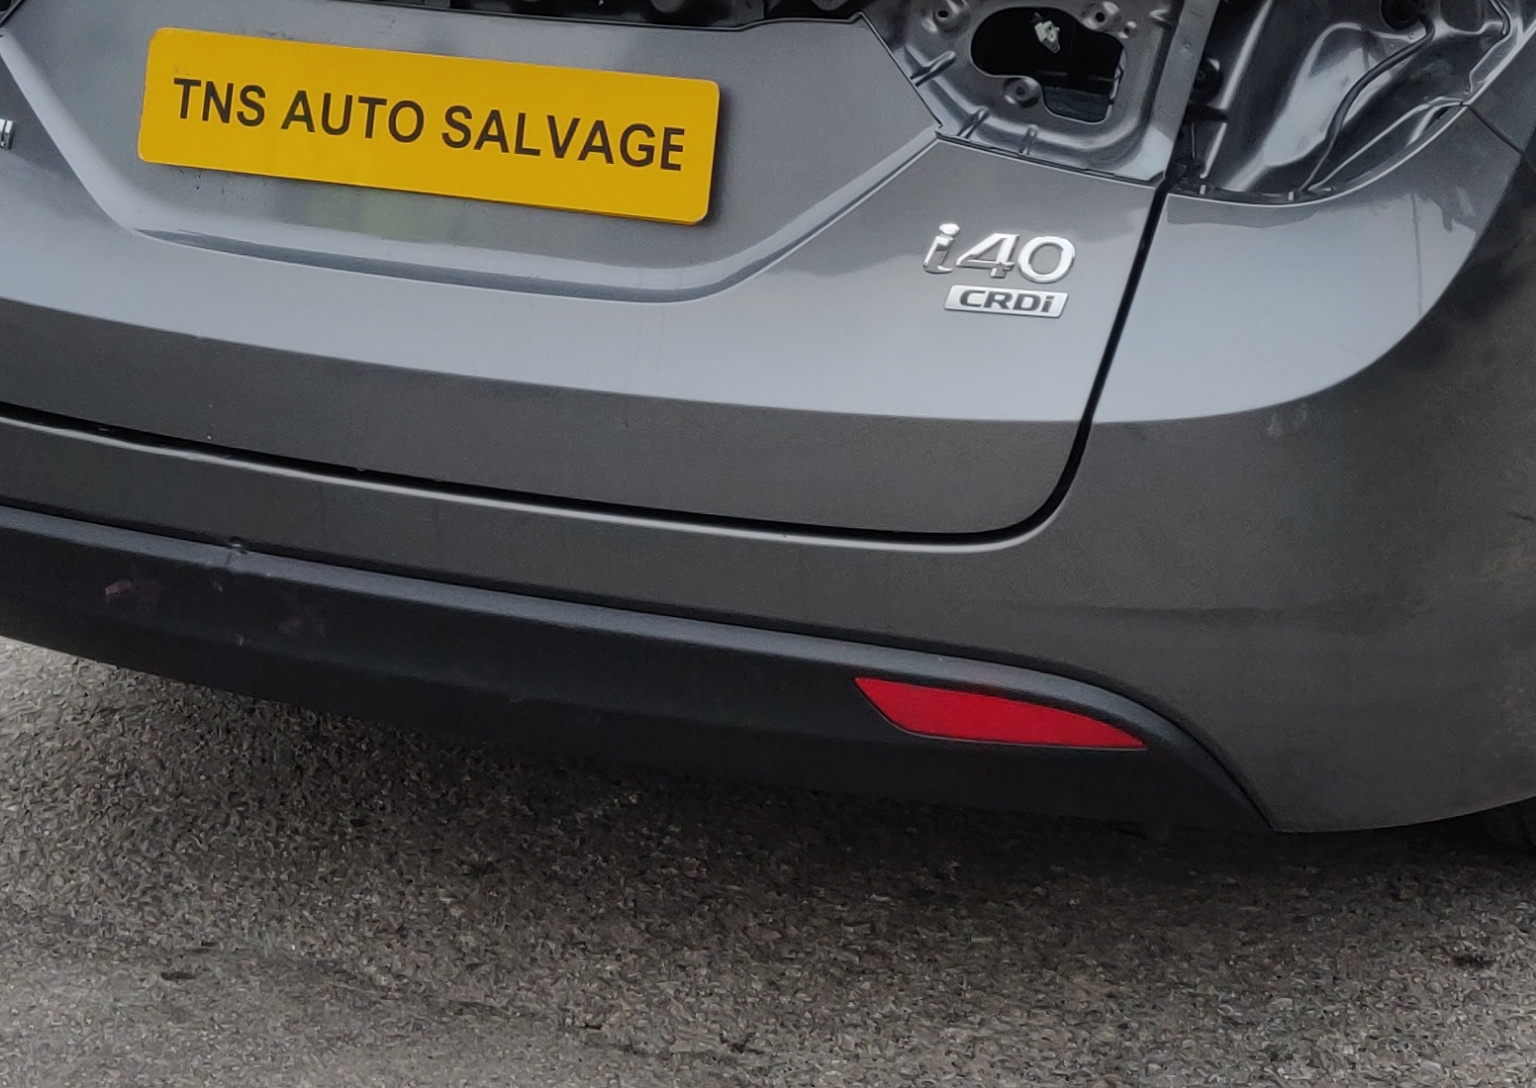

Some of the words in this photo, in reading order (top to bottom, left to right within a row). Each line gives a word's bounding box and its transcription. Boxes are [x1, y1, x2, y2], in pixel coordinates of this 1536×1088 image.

[173, 77, 266, 127] TNS
[280, 90, 425, 143] AUTO
[441, 105, 685, 172] SALVAGE
[922, 222, 1076, 285] i40
[959, 289, 1055, 313] CRDi
